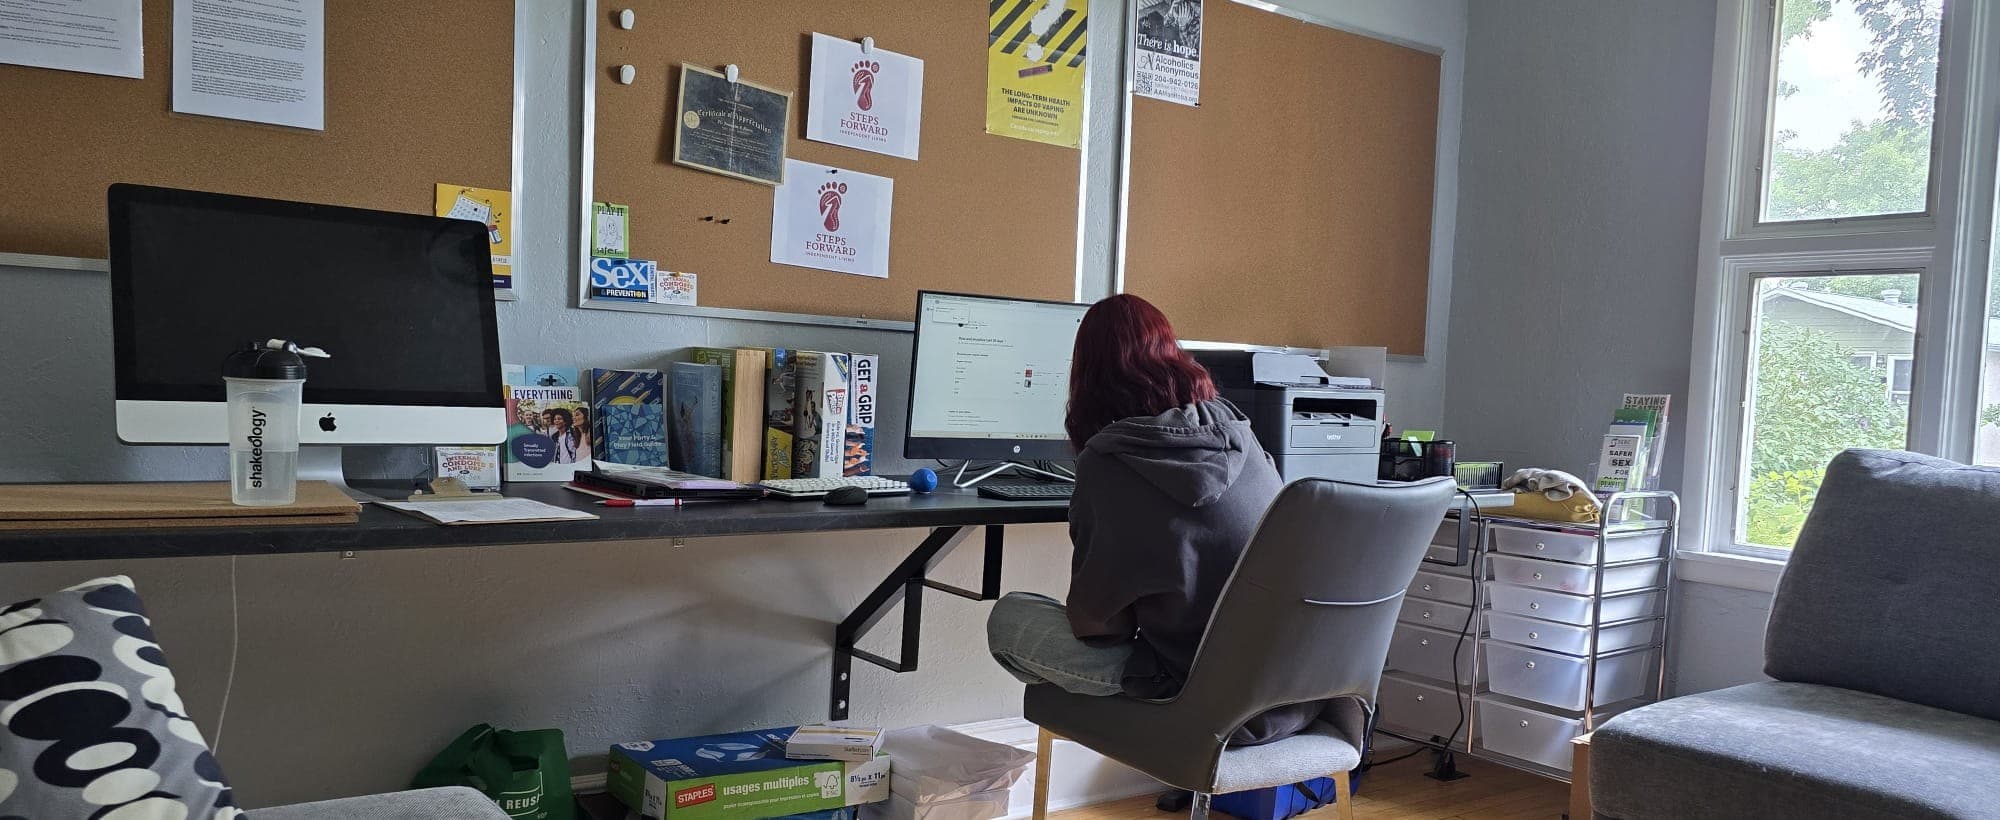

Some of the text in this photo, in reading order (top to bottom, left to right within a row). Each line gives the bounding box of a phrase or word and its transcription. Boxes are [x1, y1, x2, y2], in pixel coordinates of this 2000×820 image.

[1138, 33, 1199, 58] There is hope.
[1155, 55, 1194, 70] Alcoholics
[1155, 63, 1199, 79] Anonymous
[1001, 88, 1071, 106] THE LONG-TERM HEALTH
[1007, 97, 1033, 107] IMPACTS
[1042, 103, 1065, 113] VAPING
[850, 112, 879, 125] STEPS
[1013, 106, 1025, 114] ARE
[1026, 108, 1058, 120] UNKNOWN
[840, 119, 888, 136] FORWARD
[816, 233, 846, 246] STEPS
[806, 241, 856, 256] FORWARD
[591, 258, 648, 288] Sex
[858, 359, 871, 383] GET
[514, 389, 573, 400] EVERYTHING
[1625, 395, 1666, 406] STAYING
[859, 395, 872, 425] GRIP
[249, 409, 266, 488] shakeology
[1611, 459, 1631, 467] SEX
[723, 775, 809, 796] usages multiples
[677, 787, 714, 803] STAPLES
